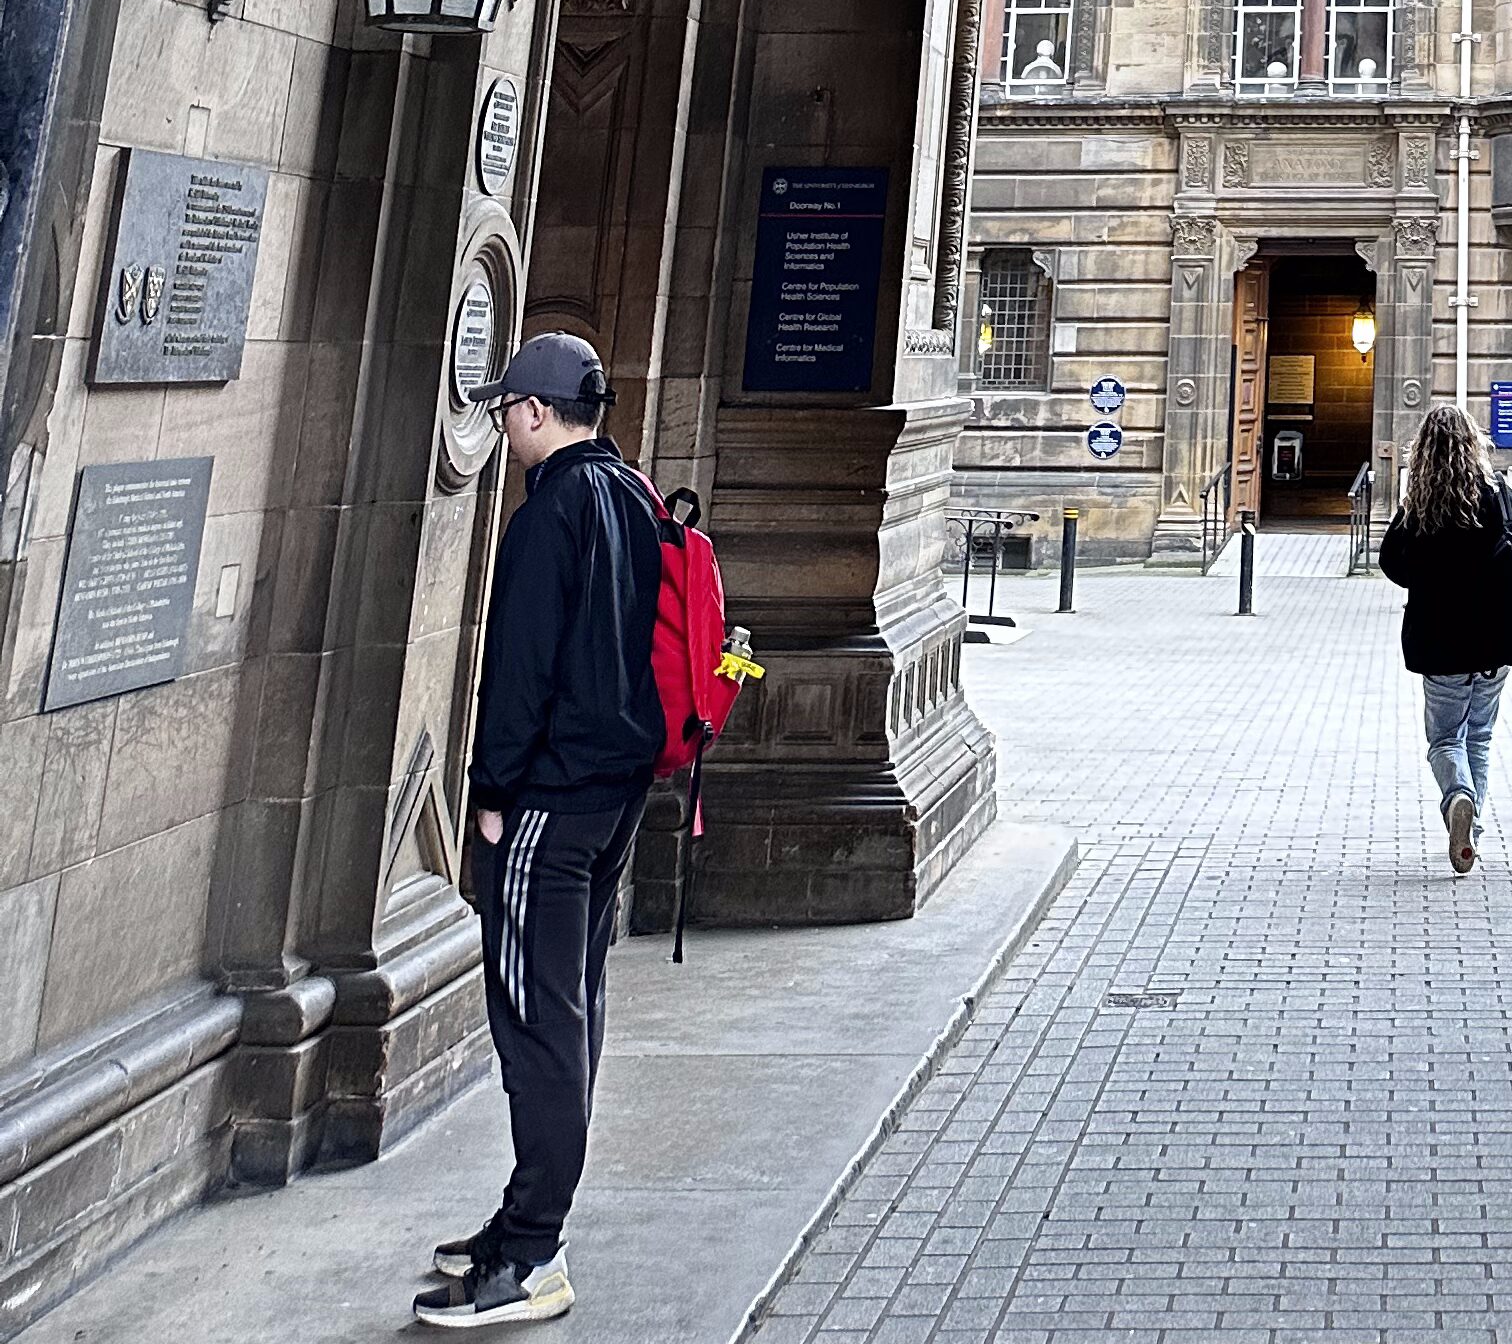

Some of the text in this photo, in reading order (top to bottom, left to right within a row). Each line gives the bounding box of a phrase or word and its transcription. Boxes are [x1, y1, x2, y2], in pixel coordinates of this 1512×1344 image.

[790, 202, 822, 210] Doorway
[786, 232, 808, 240] Usher
[841, 232, 848, 240] of
[785, 242, 850, 250] Population Health
[785, 252, 818, 260] Sciences
[784, 262, 824, 270] Informatics
[782, 282, 859, 291] Centre for Population
[807, 293, 840, 301] Sciences
[779, 313, 842, 321] Centre for Global
[778, 323, 838, 331] Health Research
[776, 343, 801, 352] Centre
[815, 344, 844, 352] Medical
[775, 354, 816, 362] Informatics
